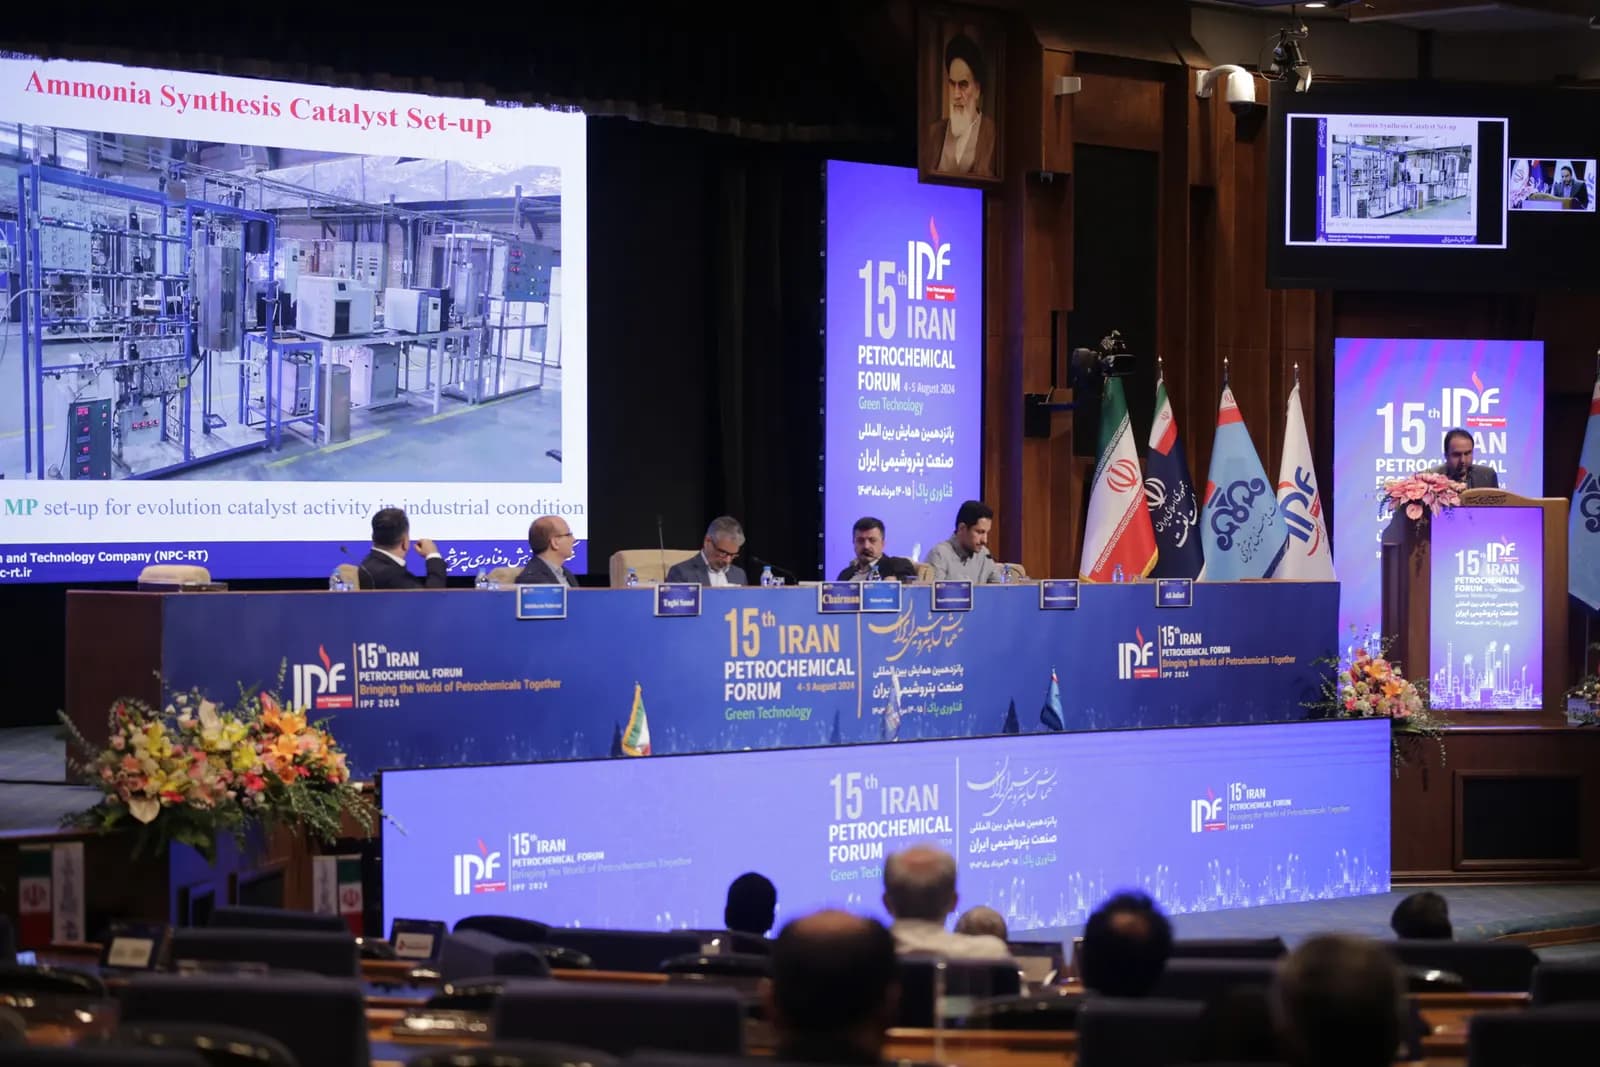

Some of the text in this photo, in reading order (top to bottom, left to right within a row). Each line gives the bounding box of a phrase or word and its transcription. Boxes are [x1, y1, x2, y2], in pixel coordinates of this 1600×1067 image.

[25, 70, 493, 139] Ammonia Synthesis Catalyst Set-up
[907, 306, 956, 341] IRAN
[858, 345, 956, 369] PETROCHEMICAL
[858, 371, 900, 392] FORUM
[917, 382, 939, 396] August
[940, 384, 955, 394] 2024
[859, 396, 924, 416] Green Technology
[896, 424, 920, 441] همایش
[921, 426, 954, 445] پانزدهمین
[1376, 402, 1440, 455] 15th
[858, 448, 953, 476] صنعت پتروشیمی ایران
[4, 498, 38, 516] MP
[44, 500, 98, 520] set-up
[105, 498, 131, 516] for
[137, 498, 222, 516] evolution
[228, 498, 298, 519] catalyst
[303, 498, 373, 520] activity
[403, 498, 489, 516] industrial
[496, 498, 585, 516] condition
[6, 549, 209, 564] and Technology Company (NPC-RT)
[1487, 563, 1520, 575] IRAN
[724, 607, 840, 658] 15th IRAN
[1180, 633, 1202, 645] IRAN
[358, 642, 419, 669] 15th IRAN
[1162, 646, 1231, 657] PETROCHEMICAL FORUM
[359, 667, 463, 681] PETROCHEMICAL FORUM
[724, 658, 855, 680] PETROCHEMICAL
[908, 664, 931, 677] همایش
[932, 663, 964, 677] پانزدهمین
[360, 678, 562, 697] Bringing the World of Petrochemicals Together
[724, 681, 781, 702] FORUM
[812, 681, 836, 693] August
[872, 682, 890, 699] یران
[937, 681, 964, 692] صنعت
[360, 699, 375, 708] IPF
[378, 698, 400, 708] 2024
[725, 705, 812, 721] Green Technology
[829, 771, 939, 821] 15th IRAN
[1246, 788, 1266, 800] IRAN
[829, 816, 952, 842] PETROCHEMICAL
[537, 838, 566, 854] IRAN
[969, 836, 989, 853] ایران
[991, 834, 1029, 851] پتروشیمی
[1031, 833, 1057, 844] صنعت
[512, 851, 605, 868] PETROCHEMICAL FORUM
[829, 841, 883, 864] FORUM
[830, 868, 858, 882] Green
